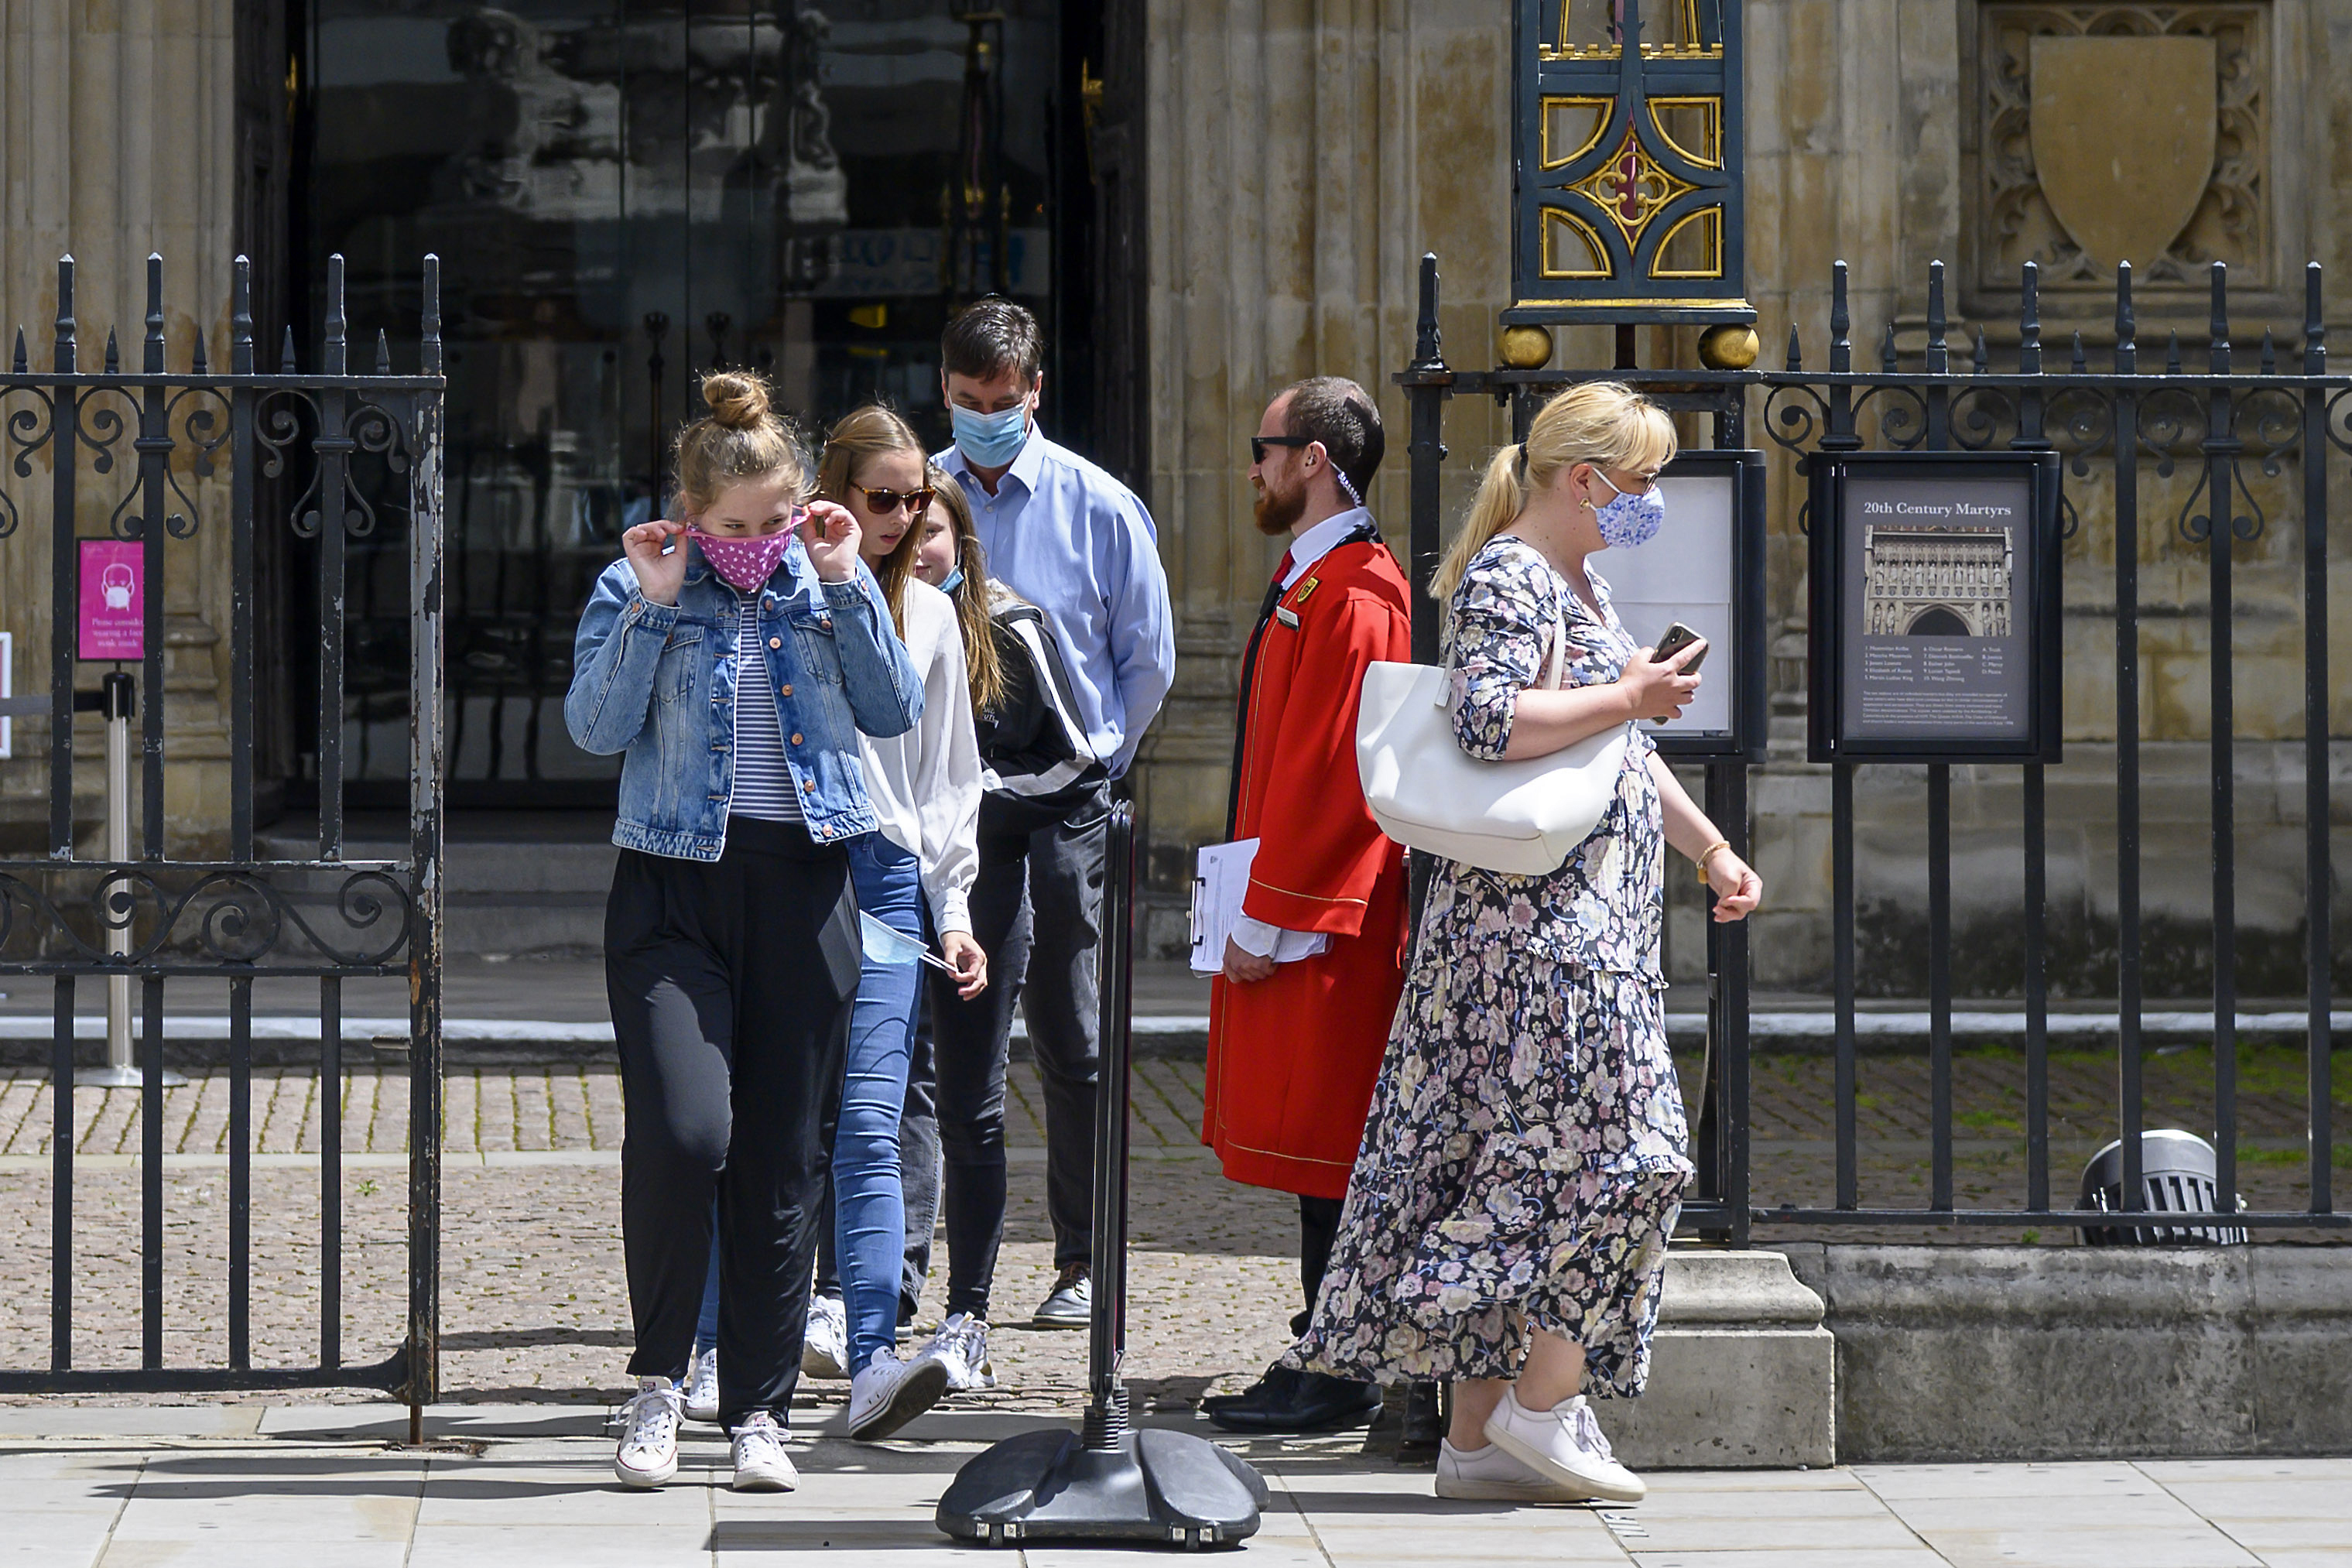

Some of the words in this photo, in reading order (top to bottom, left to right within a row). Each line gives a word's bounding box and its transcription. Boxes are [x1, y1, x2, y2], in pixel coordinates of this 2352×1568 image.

[1864, 502, 1892, 514] 20th
[1896, 502, 1952, 518] Century
[1956, 503, 2011, 518] Martyrs
